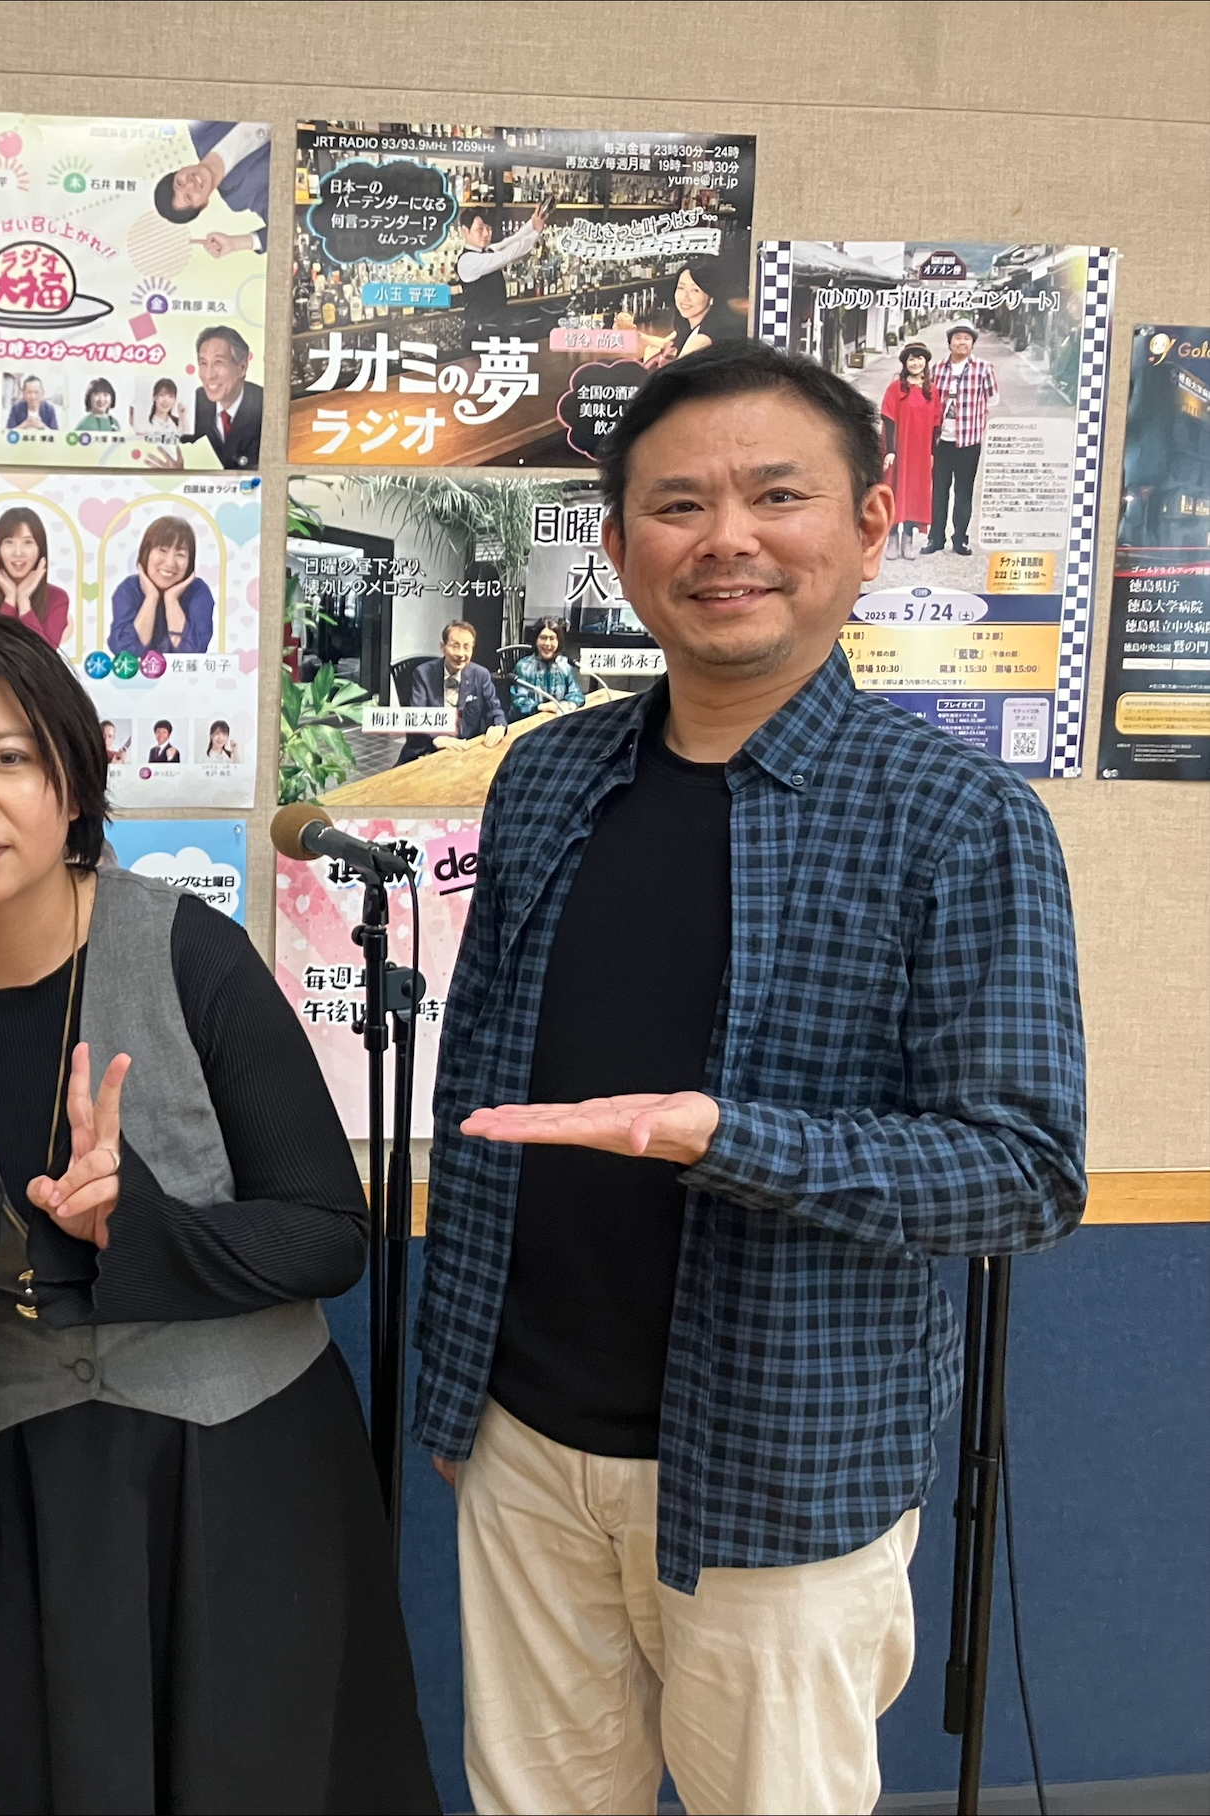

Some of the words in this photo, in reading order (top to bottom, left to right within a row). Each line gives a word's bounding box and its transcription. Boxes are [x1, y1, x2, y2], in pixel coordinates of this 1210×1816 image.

[312, 136, 336, 148] JRT
[338, 137, 378, 149] RADIO
[381, 138, 447, 151] 93/93.9MHz
[451, 140, 496, 153] 1269kHz
[604, 142, 651, 156] 毎週金曜
[565, 156, 651, 171] 再放送/毎週月曜
[90, 179, 110, 191] 石井
[330, 179, 383, 195] 日本一の
[668, 174, 739, 188] yume@jrt.jp
[336, 195, 446, 212] バーテンダーになる
[377, 233, 428, 246] なんつって
[1, 246, 60, 273] ラジオ
[374, 286, 403, 302] 小玉
[408, 287, 438, 303] 晋平
[596, 333, 625, 349] 尚美
[305, 331, 540, 426] ナオミの夢
[311, 406, 447, 456] ラジオ
[532, 503, 603, 547] 日曜
[304, 556, 427, 577] 日曜の昼下がり、
[1129, 578, 1180, 594] 徳島県庁
[1127, 598, 1204, 614] 徳島大学病院
[1173, 639, 1209, 654] 鷲の門
[171, 658, 198, 673] 佐藤
[589, 653, 617, 669] 岩瀬
[371, 711, 399, 727] 梅津
[404, 711, 448, 727] 龍太郎
